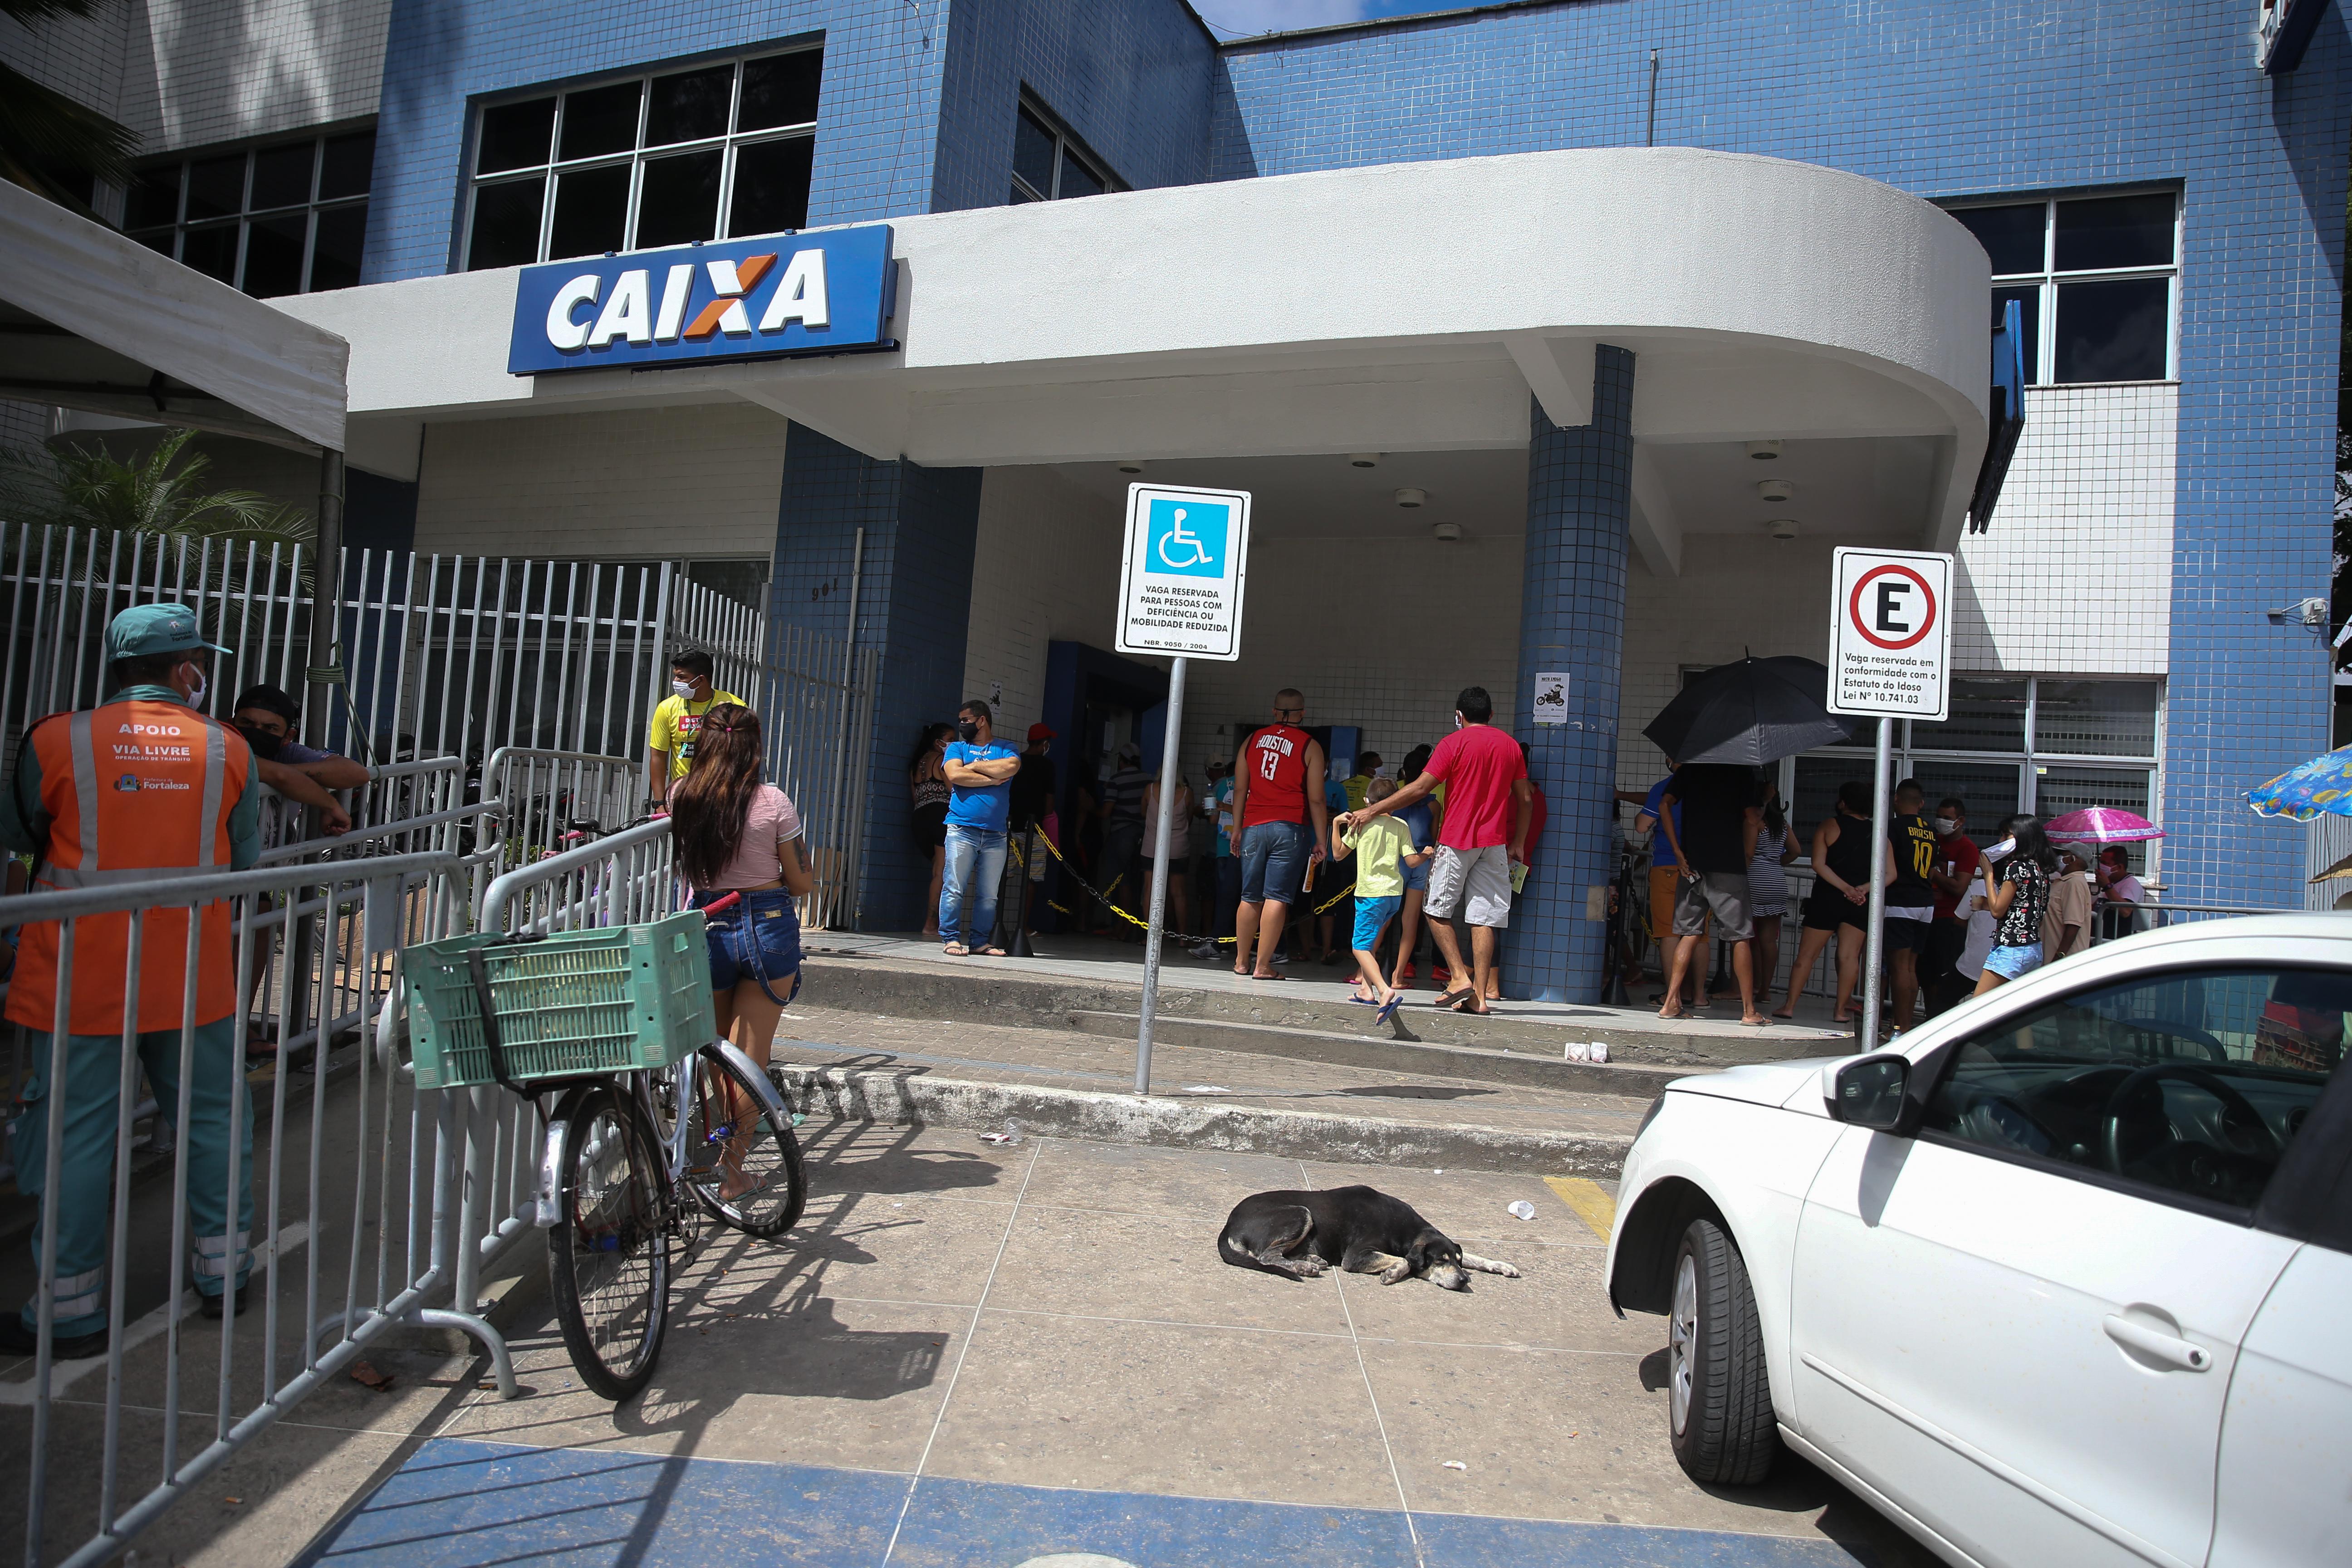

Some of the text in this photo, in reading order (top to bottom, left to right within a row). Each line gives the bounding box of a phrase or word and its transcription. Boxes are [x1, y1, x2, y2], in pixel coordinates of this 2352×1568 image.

[546, 248, 831, 351] CAIXA
[1146, 585, 1219, 598] VAGA RESERVADA
[1140, 597, 1222, 610] PARA PESSOAS COM
[1876, 582, 1911, 632] E
[1147, 608, 1214, 620] DEFICIÊNCIA OU
[1131, 617, 1228, 632] MOBILIDADE REDUZIDA
[1845, 653, 1868, 665] Vaga
[1871, 656, 1917, 666] reservada
[1844, 667, 1907, 678] conformidade
[1844, 678, 1921, 691] Estatuto do Idoso
[1843, 691, 1857, 699] Lei
[1875, 692, 1919, 704] 10.741.03
[119, 724, 181, 735] APOIO
[113, 745, 190, 755] VIA LIVRE
[1256, 735, 1294, 757] HOUSTON
[1261, 750, 1279, 781] 13
[1908, 827, 1936, 841] BRASIL
[1913, 839, 1932, 879] 10
